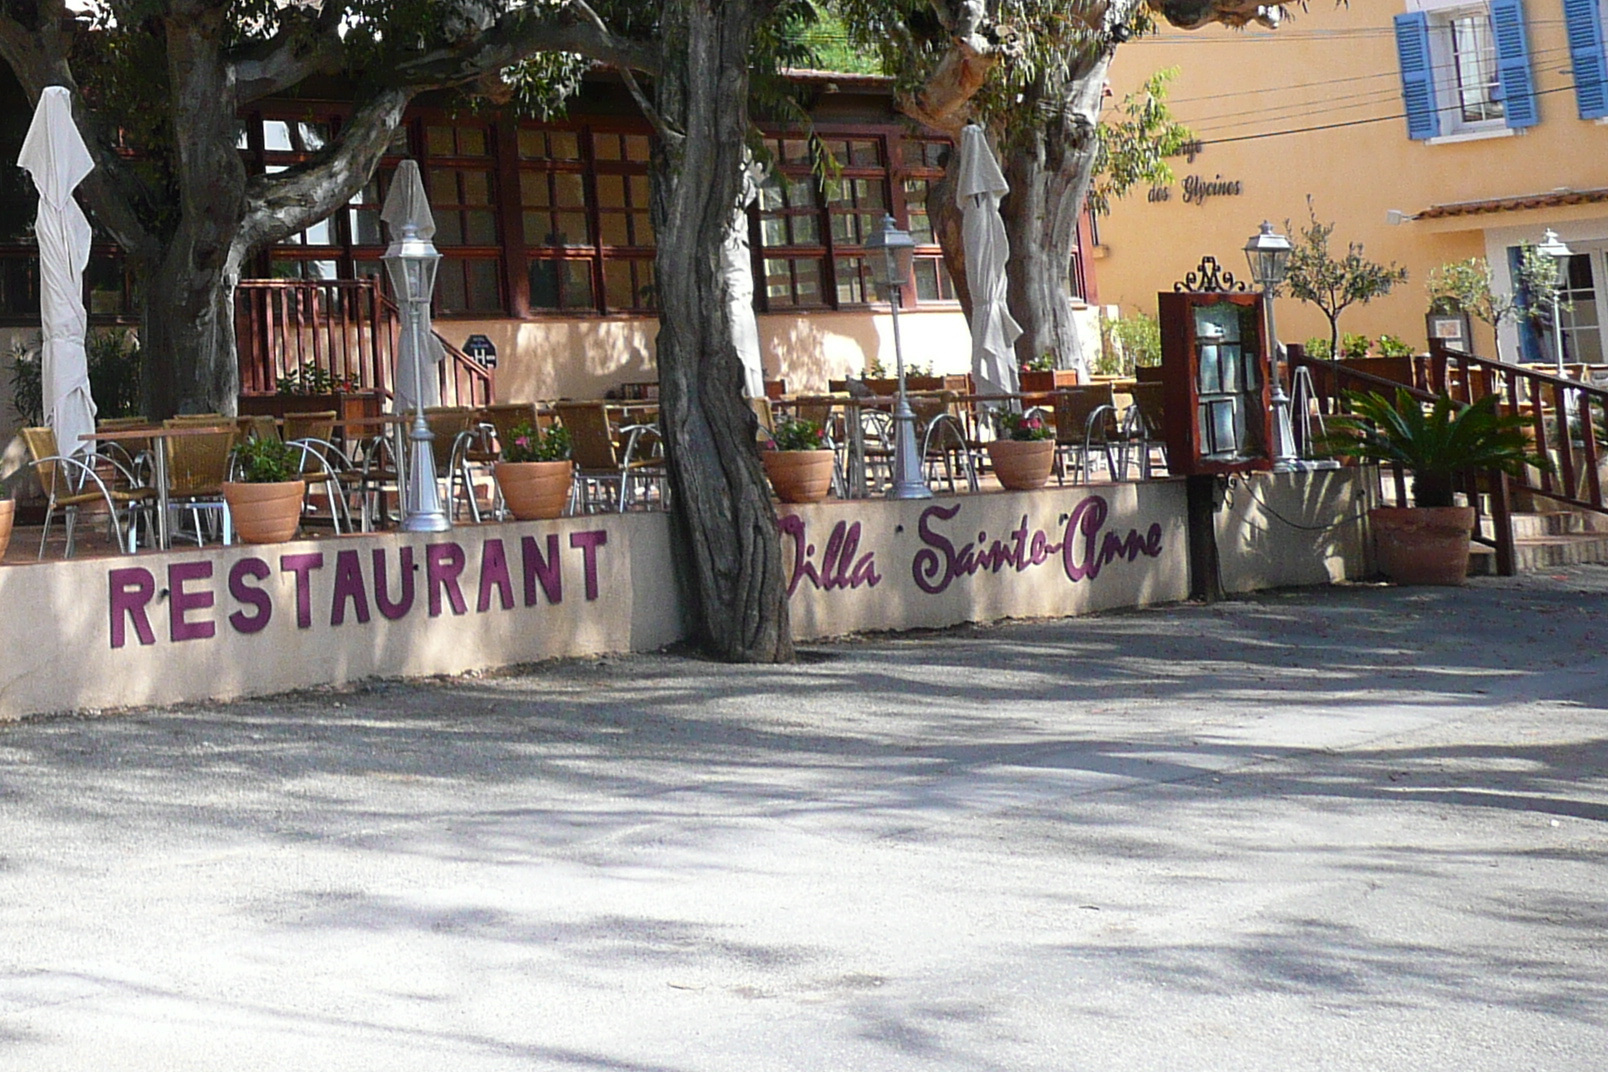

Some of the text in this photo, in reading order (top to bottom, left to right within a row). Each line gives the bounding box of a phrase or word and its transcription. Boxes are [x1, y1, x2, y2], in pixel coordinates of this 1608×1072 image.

[1148, 174, 1241, 206] des Glycines
[108, 529, 608, 649] RESTAURANT
